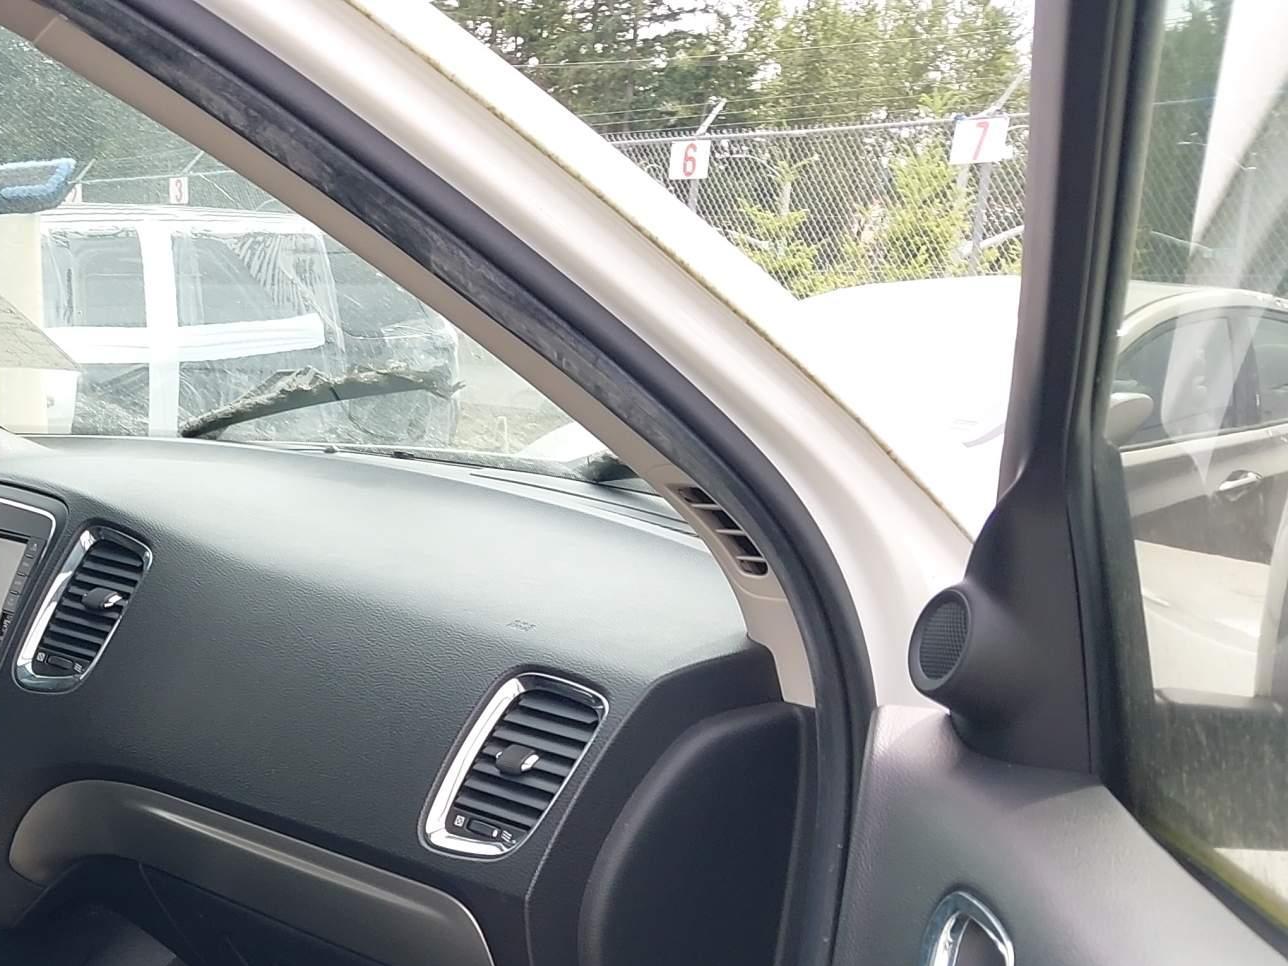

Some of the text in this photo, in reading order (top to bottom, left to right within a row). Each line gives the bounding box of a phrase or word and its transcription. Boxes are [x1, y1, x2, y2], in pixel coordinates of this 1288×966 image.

[972, 121, 990, 161] 7
[683, 142, 697, 177] 6
[175, 179, 183, 203] 3
